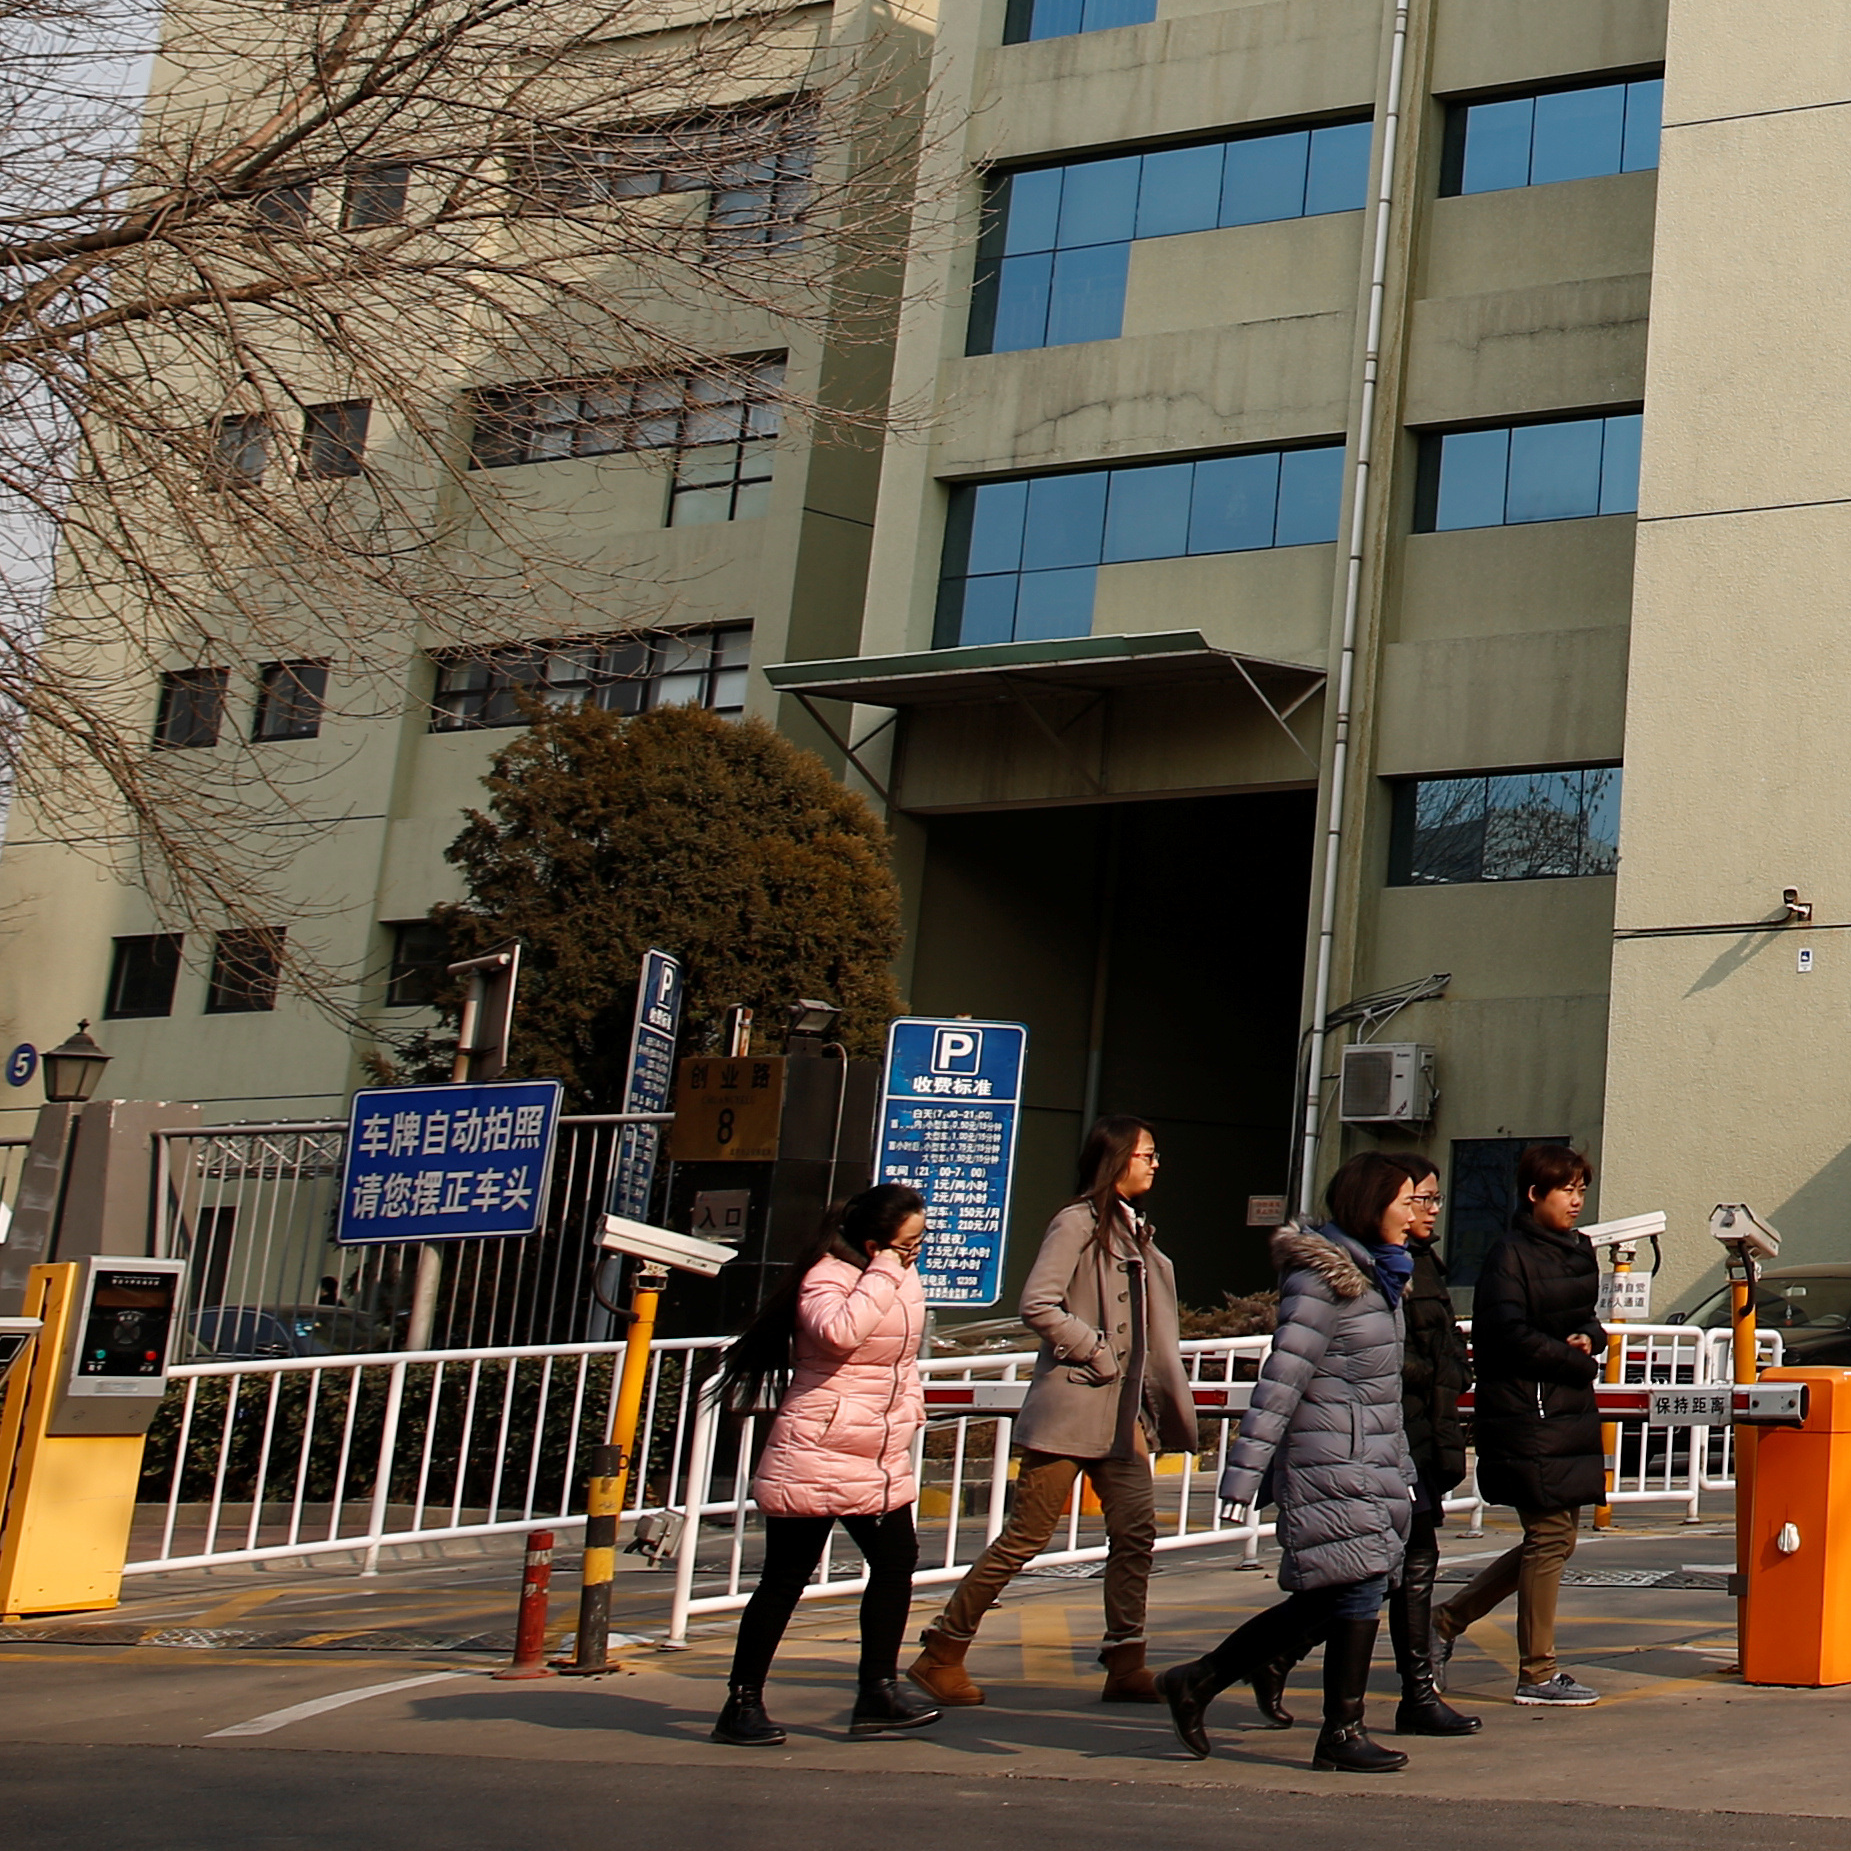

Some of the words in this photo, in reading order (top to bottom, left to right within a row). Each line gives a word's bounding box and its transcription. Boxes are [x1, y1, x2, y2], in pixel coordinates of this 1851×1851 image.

[660, 966, 673, 1001] P
[13, 1052, 31, 1077] 5
[939, 1032, 974, 1069] P
[690, 1063, 770, 1090] 创业路
[912, 1075, 993, 1097] 收费标准
[358, 1104, 546, 1158] 车牌自动拍照
[717, 1108, 734, 1145] 8
[352, 1164, 533, 1220] 请您摆正车头
[699, 1205, 742, 1229] 入口
[1656, 1396, 1725, 1415] 保持距离
